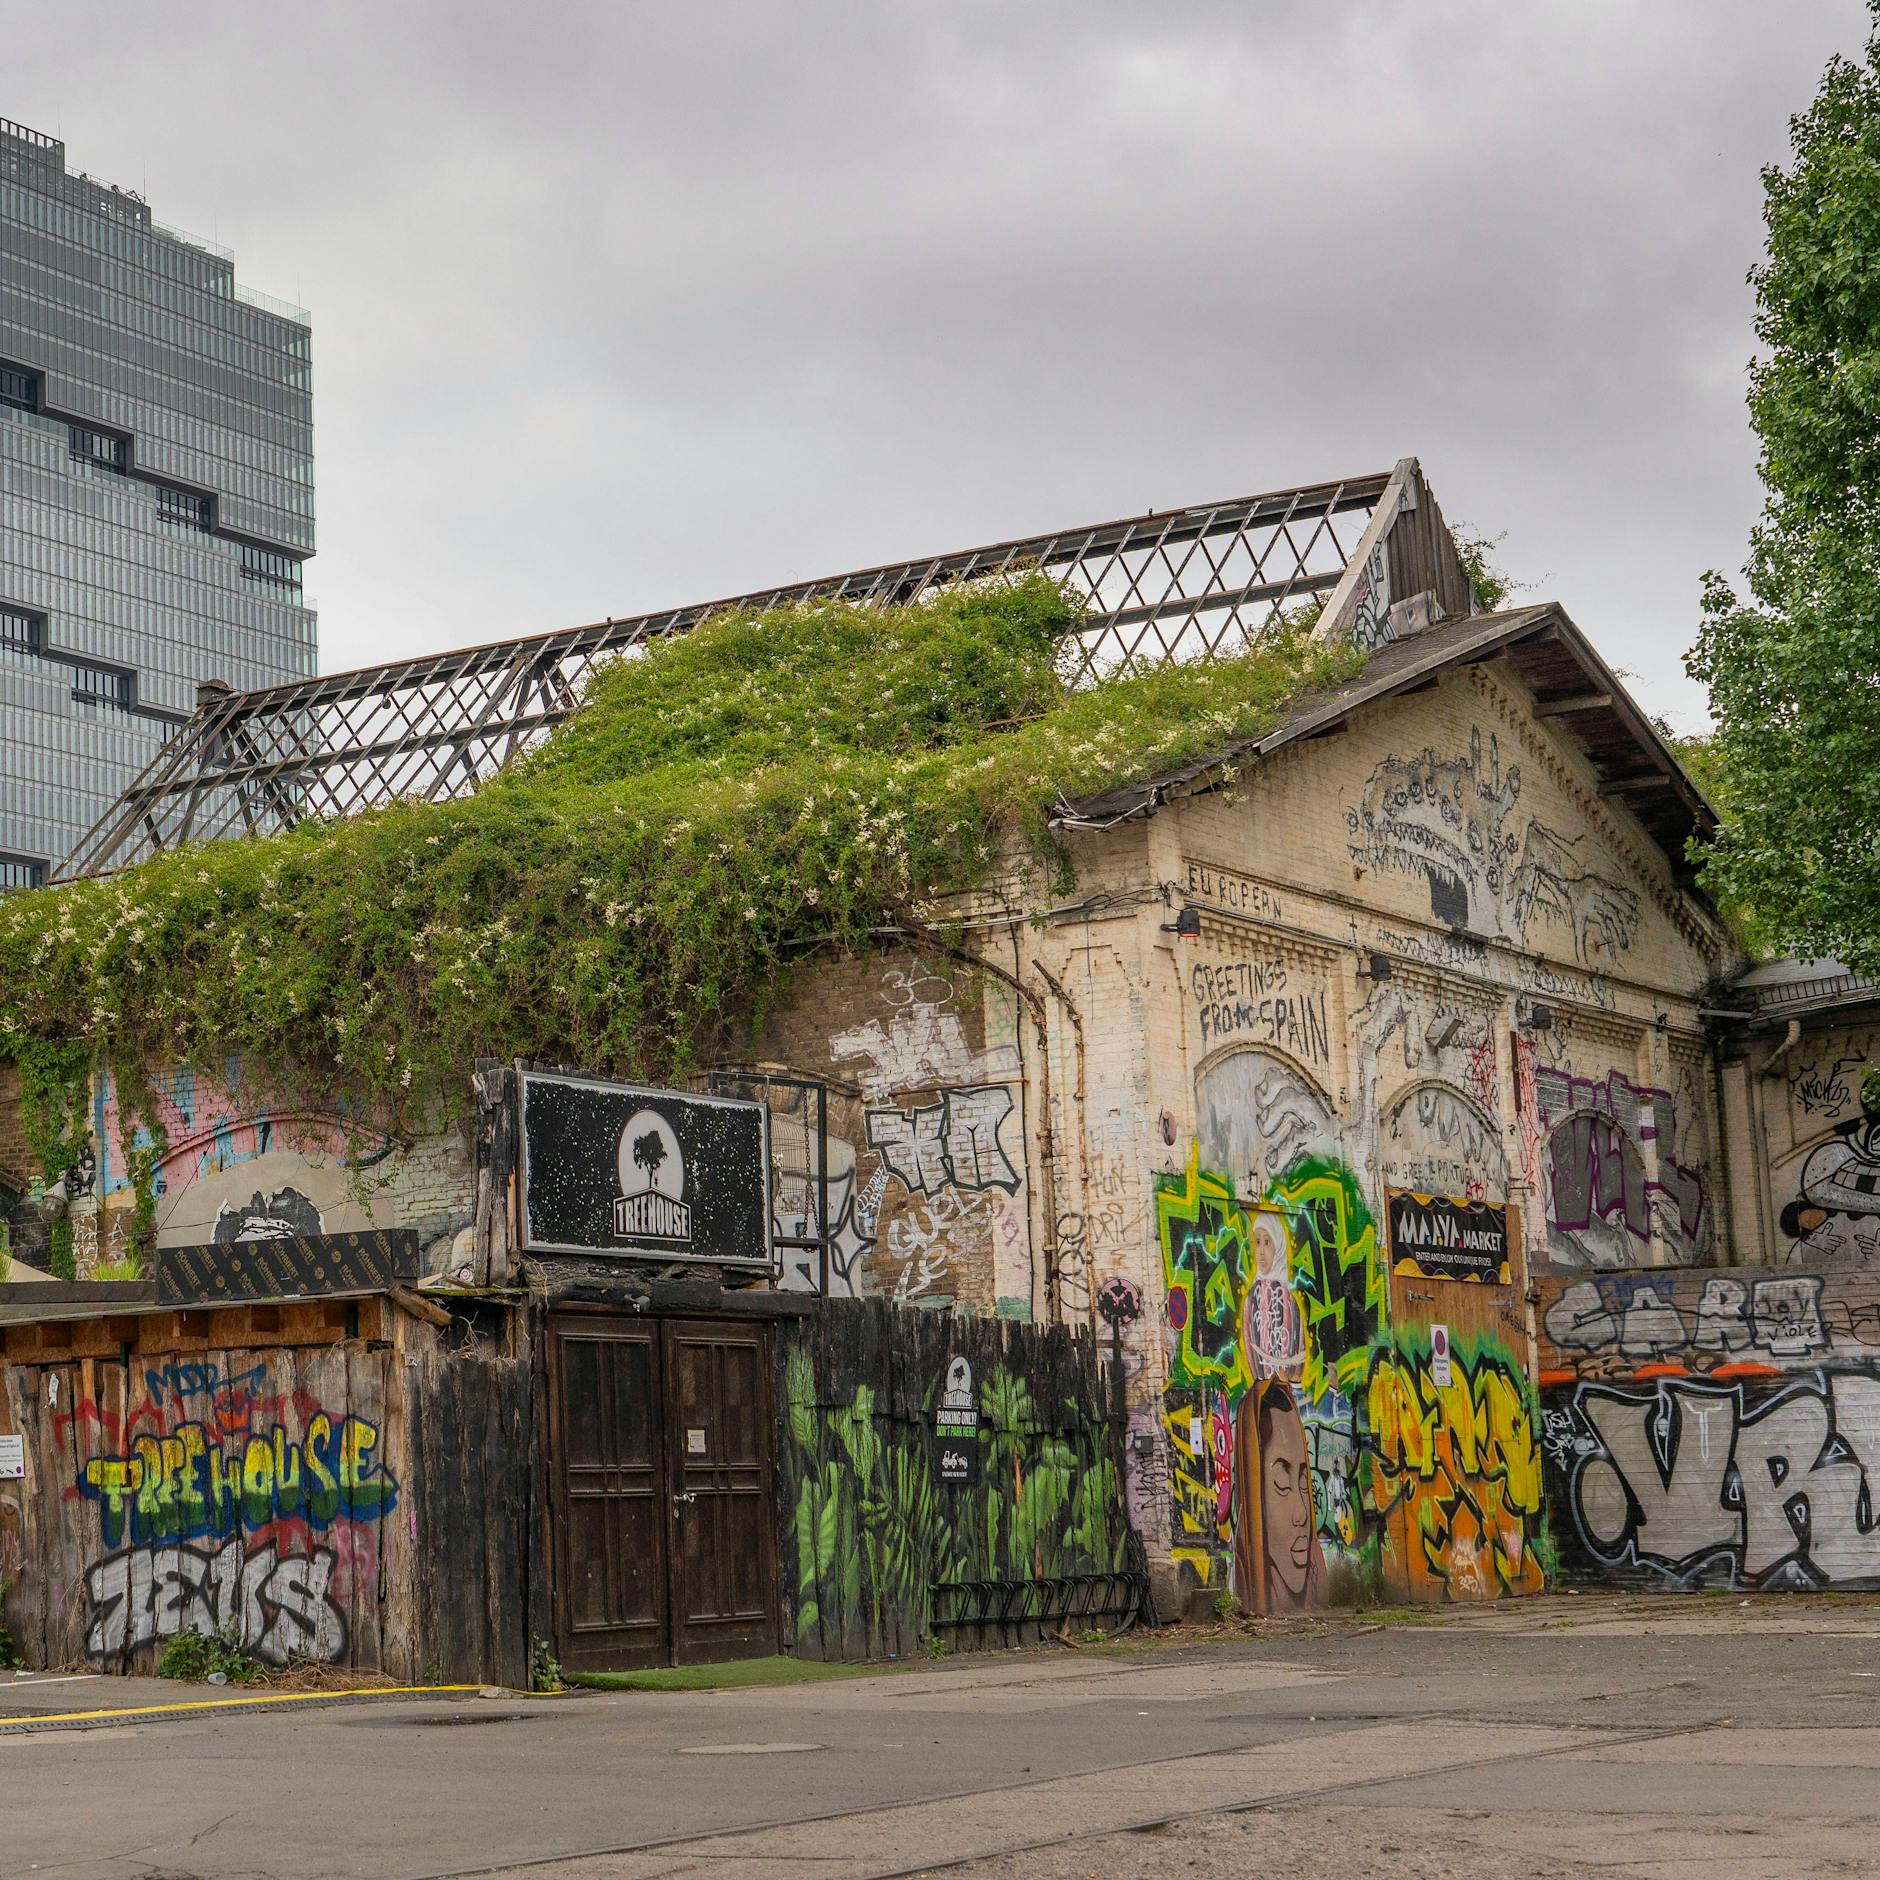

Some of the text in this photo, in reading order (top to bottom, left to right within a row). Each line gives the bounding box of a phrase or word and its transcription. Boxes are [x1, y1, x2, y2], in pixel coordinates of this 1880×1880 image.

[1192, 959, 1287, 1004] GREETINGS
[1200, 991, 1329, 1066] FROM SPAIN
[616, 1193, 689, 1237] TREEHOUSE
[1398, 1211, 1503, 1252] MAAYA MARKET
[936, 1425, 977, 1437] DON'T PARK HERE!
[937, 1410, 978, 1425] PARKING ONLY!
